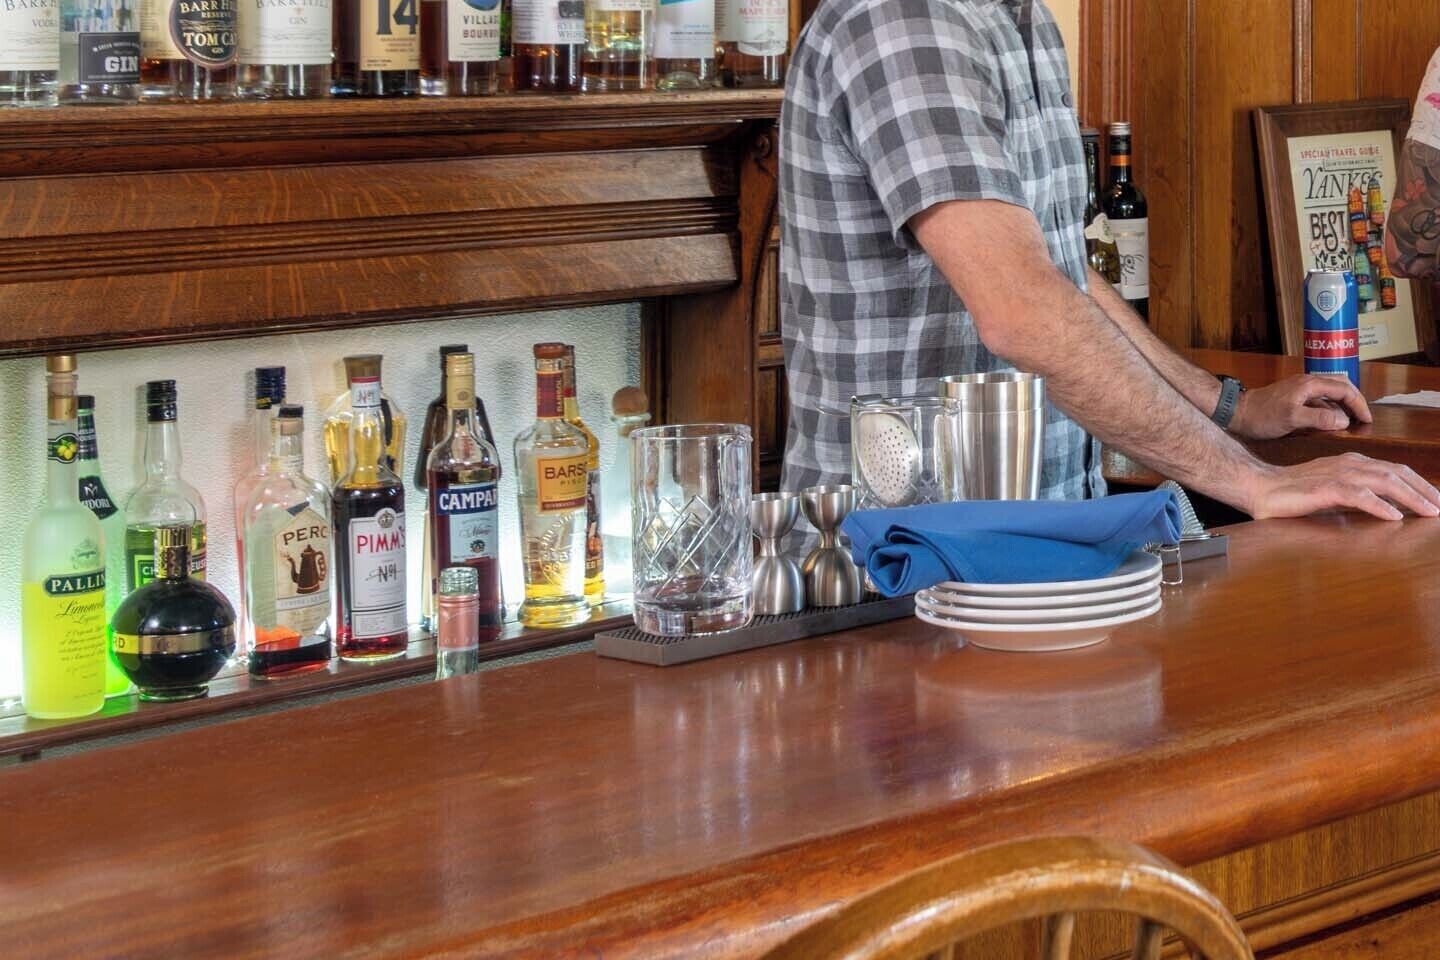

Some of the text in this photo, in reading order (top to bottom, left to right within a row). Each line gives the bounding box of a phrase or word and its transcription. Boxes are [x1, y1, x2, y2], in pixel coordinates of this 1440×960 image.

[180, 0, 218, 14] BARR
[183, 32, 218, 47] TOM
[104, 56, 138, 73] GIN
[1331, 148, 1356, 157] TRAVEL
[1303, 167, 1383, 200] YANKE
[1310, 210, 1346, 252] BEST
[80, 498, 111, 509] IDORI
